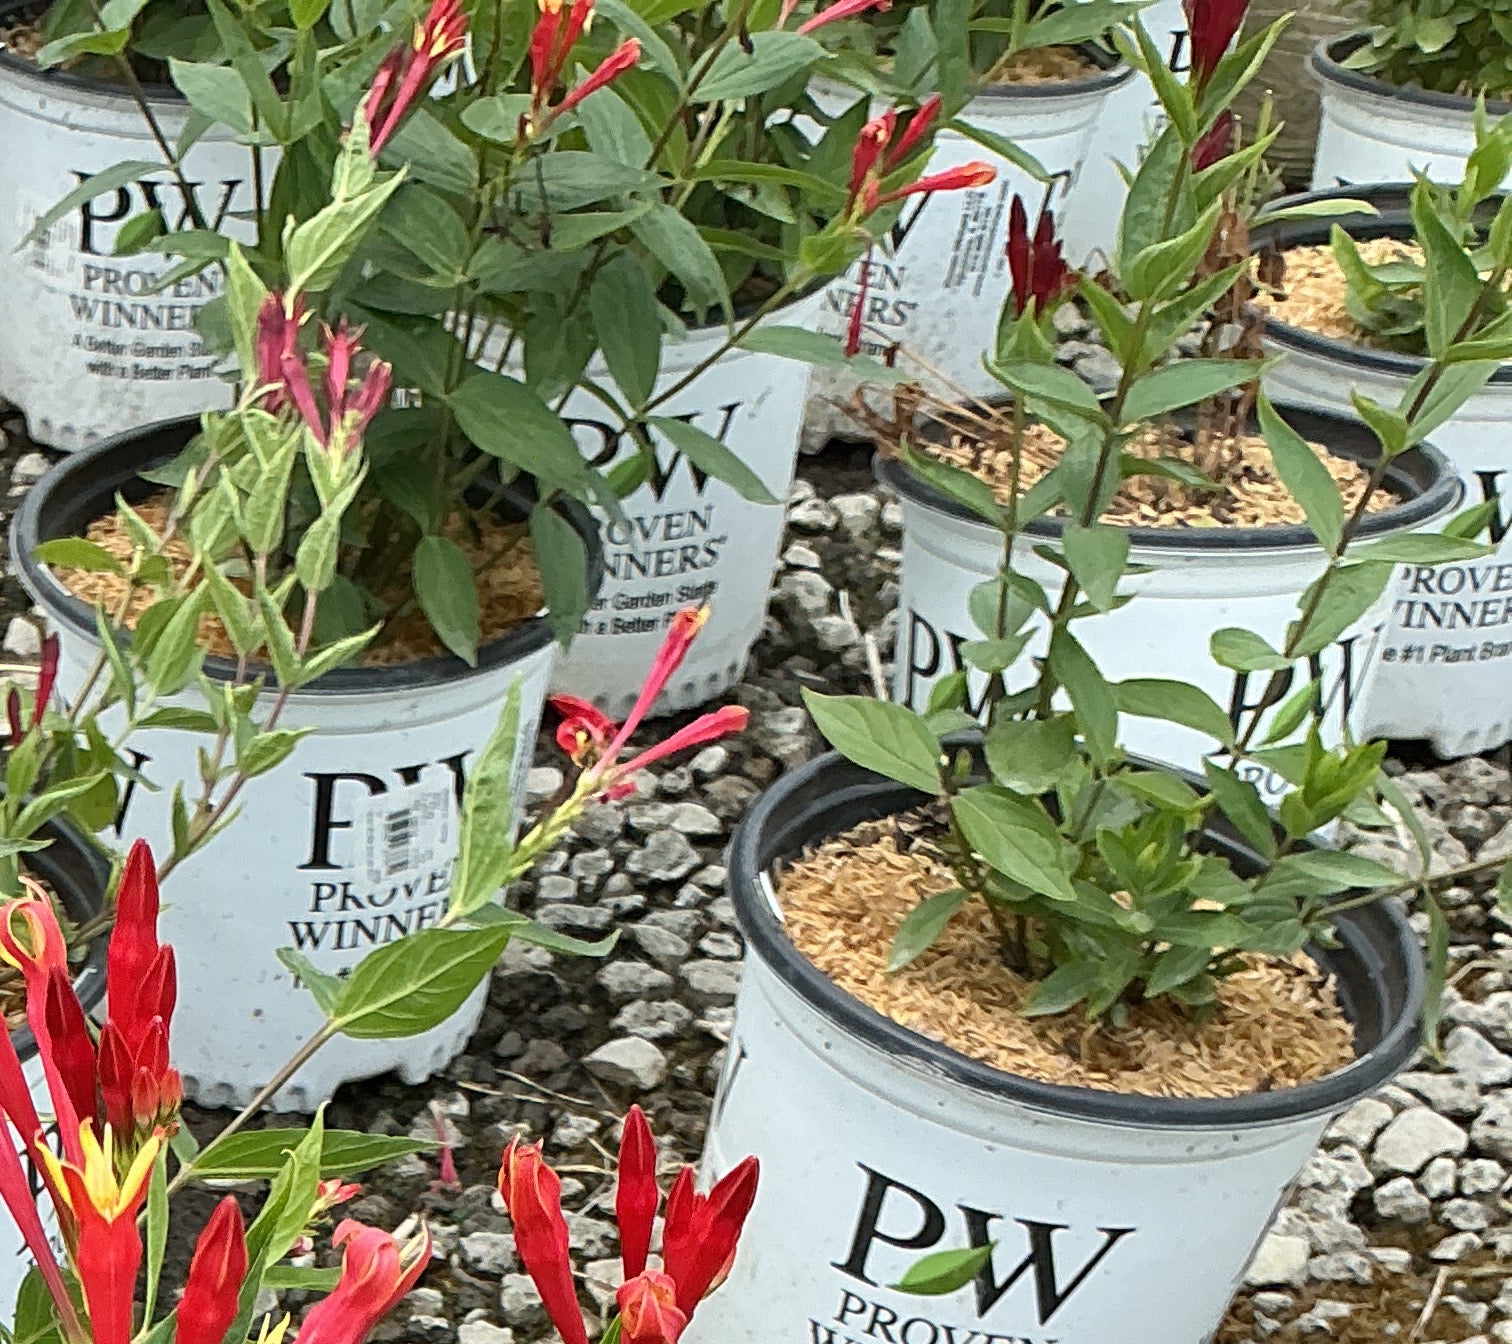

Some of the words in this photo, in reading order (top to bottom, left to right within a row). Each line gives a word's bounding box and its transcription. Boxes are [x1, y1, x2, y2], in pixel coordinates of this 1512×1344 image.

[70, 170, 243, 256] PW
[81, 263, 219, 298] PROEN
[69, 294, 201, 332] WINNE
[605, 503, 714, 546] OVEN
[603, 534, 727, 581] NNERS
[1401, 564, 1512, 594] ROVE
[1392, 597, 1512, 629] INNE
[309, 870, 451, 913] PROVE
[287, 899, 451, 951] WINNE
[829, 1160, 1138, 1326] PW
